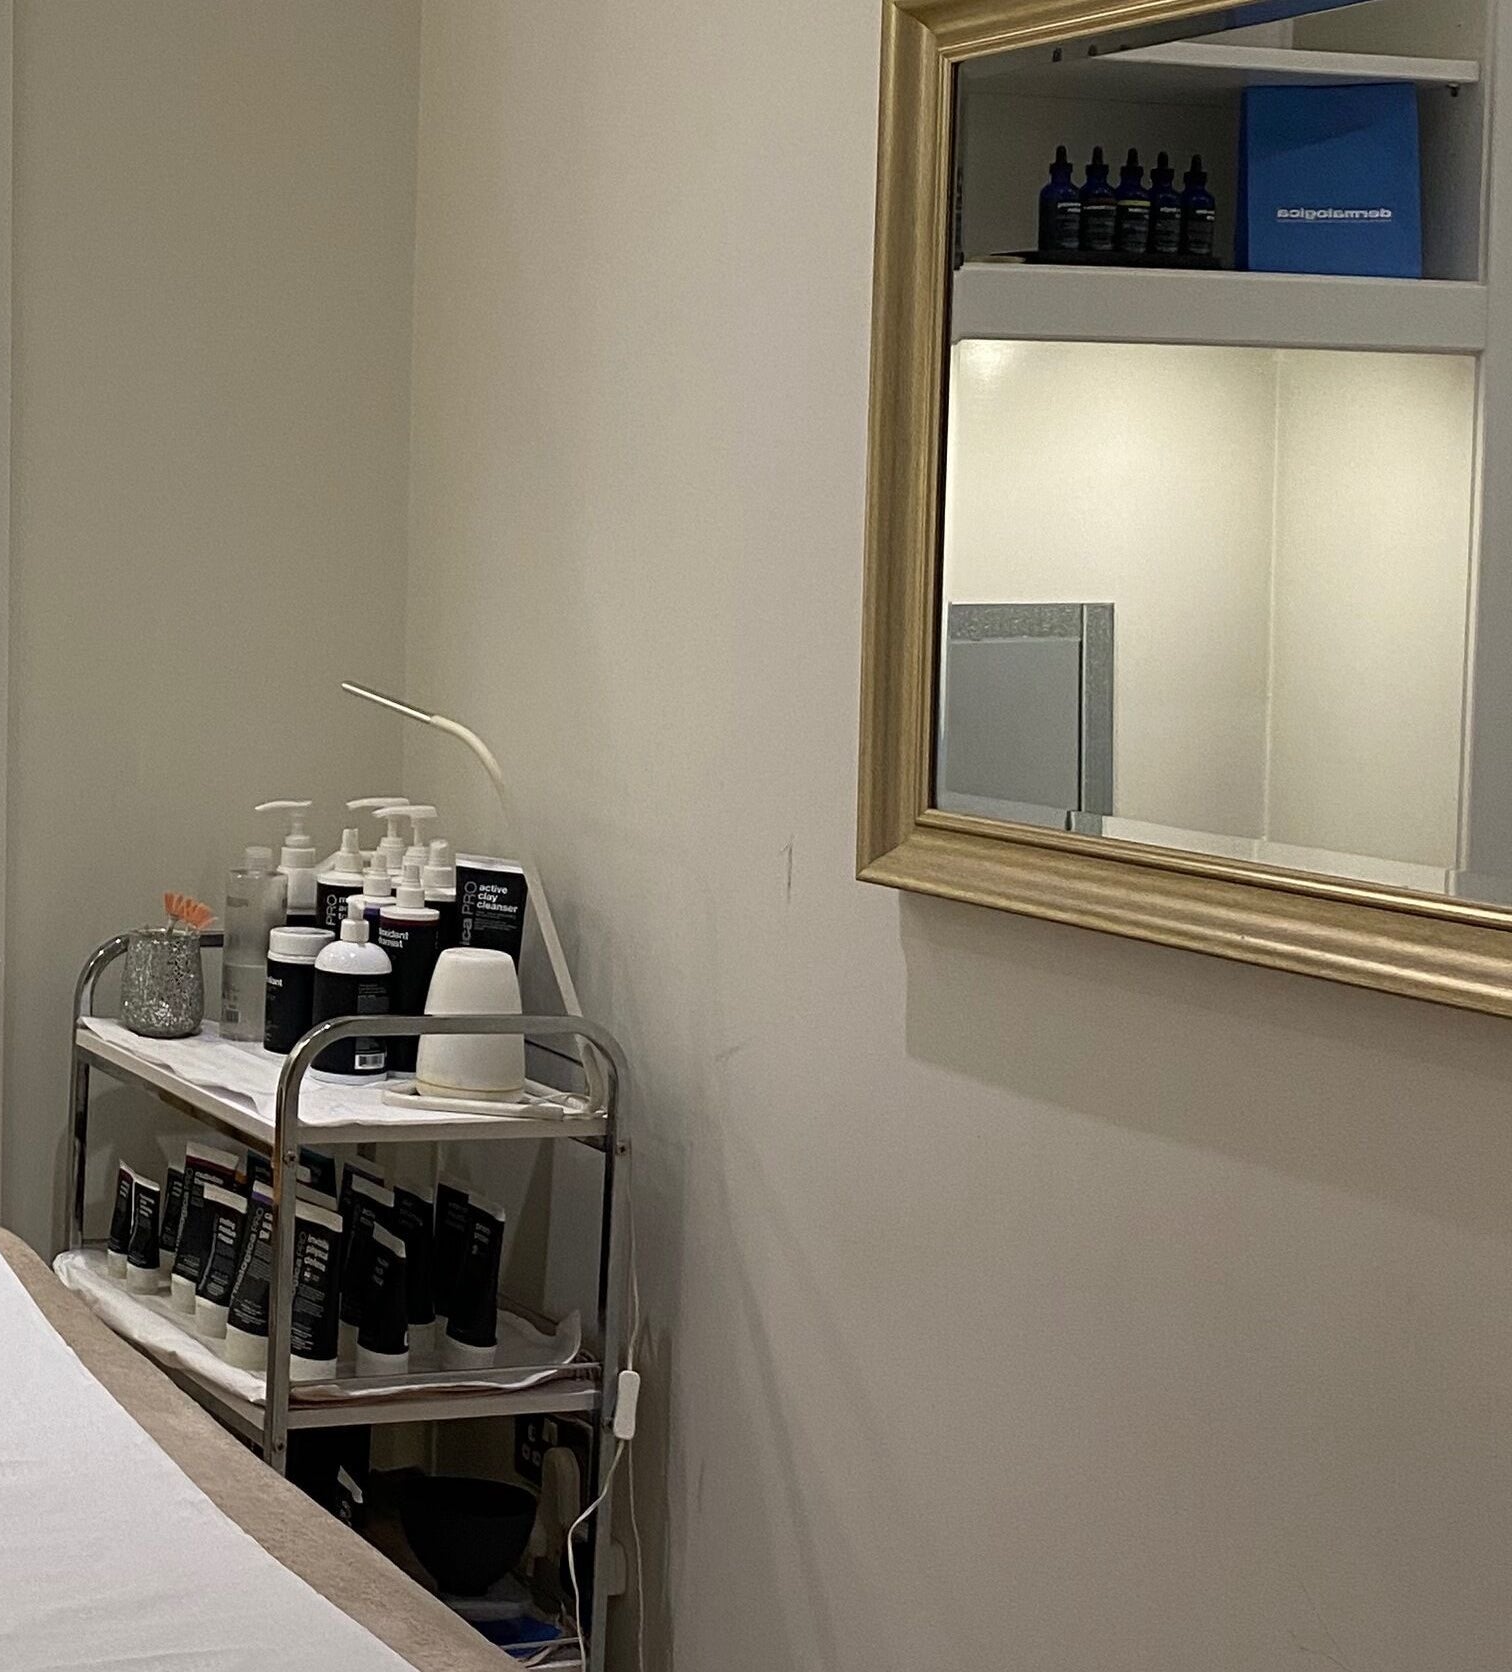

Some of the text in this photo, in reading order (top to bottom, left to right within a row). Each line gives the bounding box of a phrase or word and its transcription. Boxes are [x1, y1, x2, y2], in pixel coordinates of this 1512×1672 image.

[479, 885, 508, 894] active
[462, 881, 477, 915] PRO
[478, 892, 498, 903] clay
[326, 894, 337, 925] PRO
[476, 901, 518, 913] cleanser
